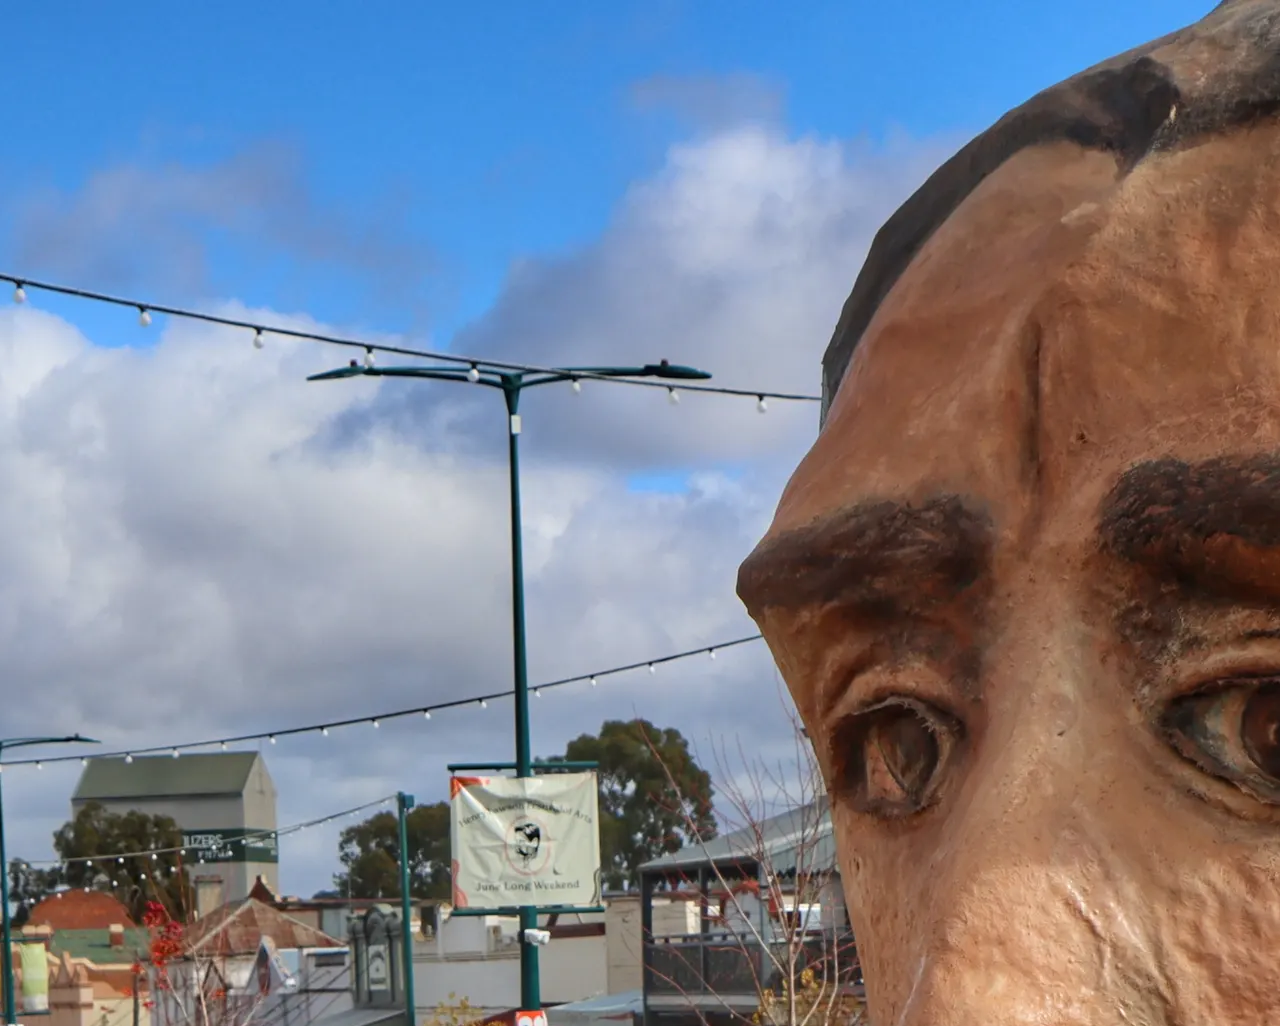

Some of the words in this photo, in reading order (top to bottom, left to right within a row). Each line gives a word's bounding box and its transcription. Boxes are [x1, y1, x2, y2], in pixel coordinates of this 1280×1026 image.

[574, 809, 593, 824] Arts
[475, 881, 501, 892] June
[504, 880, 532, 892] Long
[534, 880, 580, 891] Weekend
